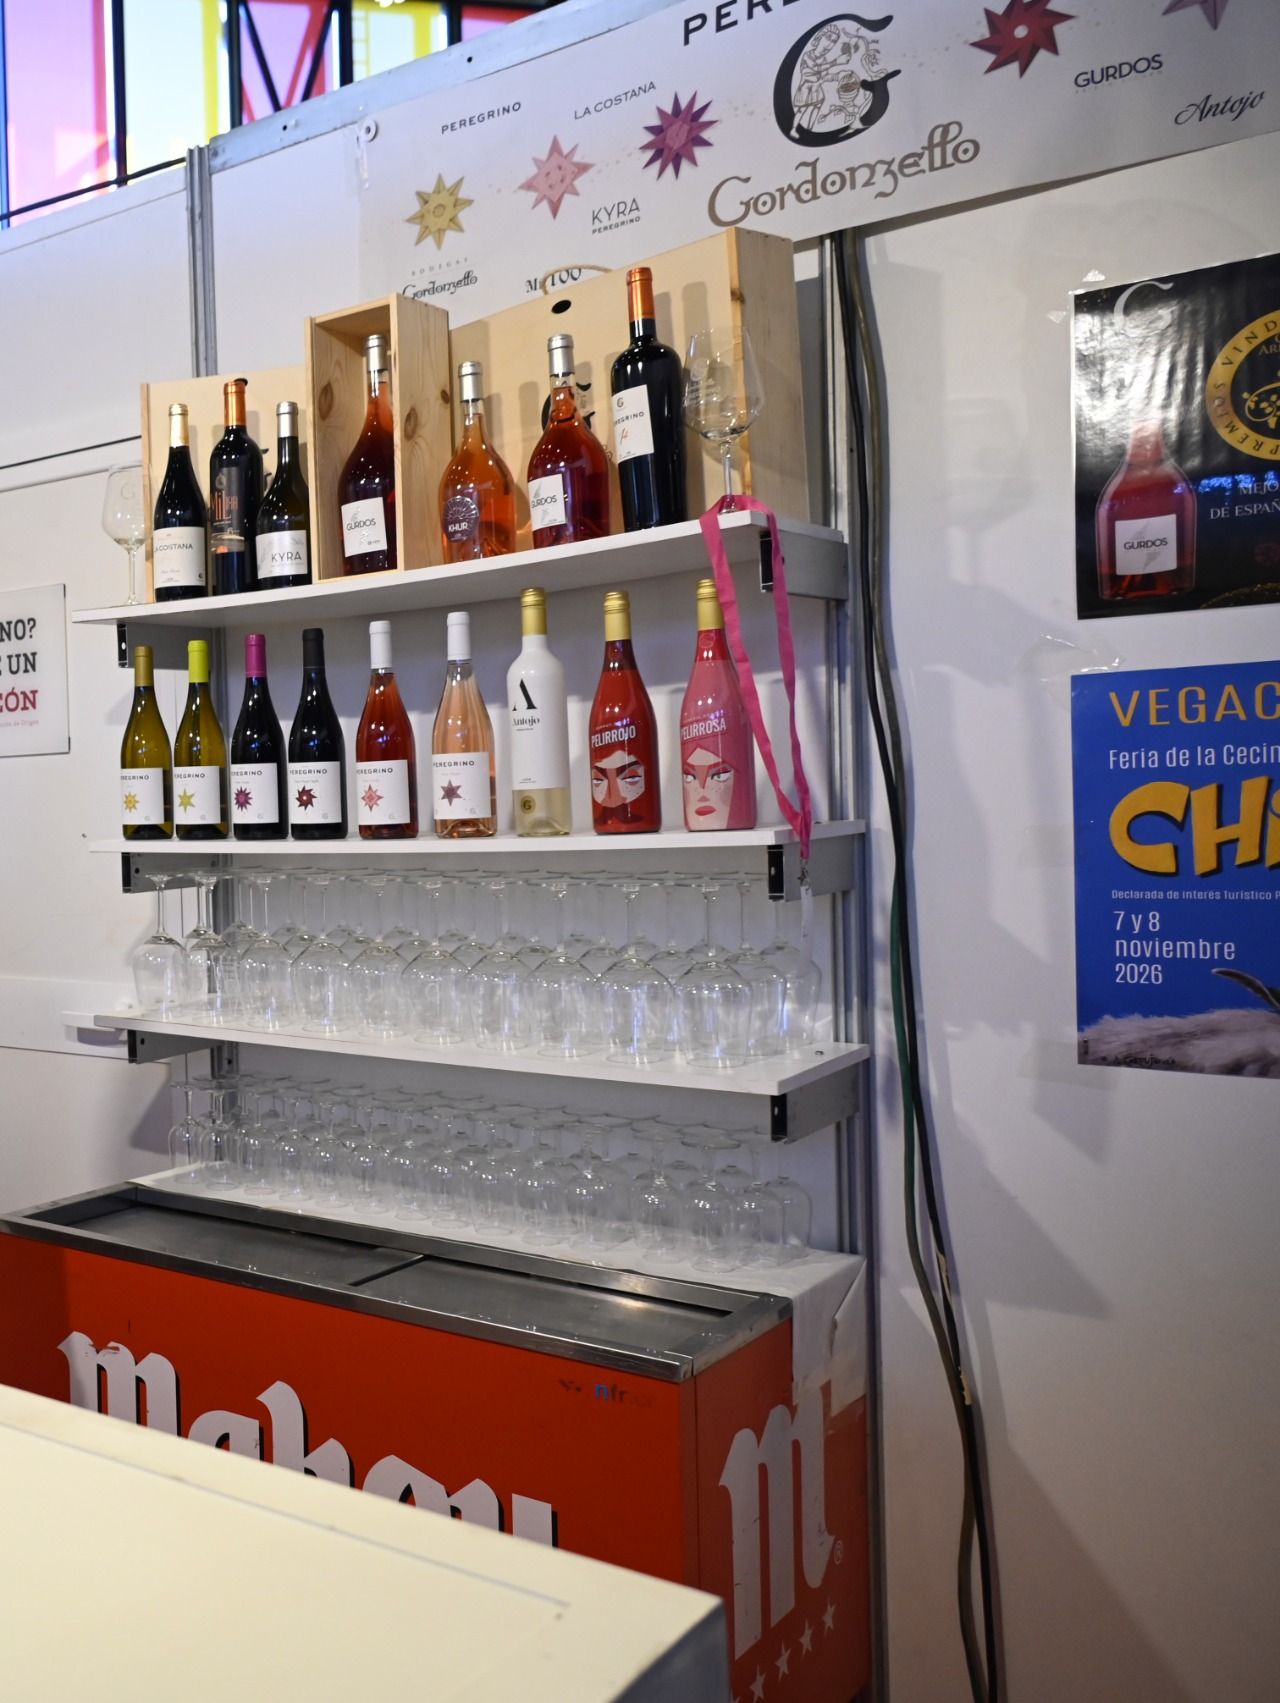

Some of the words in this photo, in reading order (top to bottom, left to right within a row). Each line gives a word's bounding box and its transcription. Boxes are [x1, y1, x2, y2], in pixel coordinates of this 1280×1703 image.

[683, 0, 801, 46] PER
[1074, 53, 1163, 88] GURDOS
[574, 105, 592, 120] LA
[594, 81, 657, 113] COSTANA
[1174, 91, 1265, 125] Antojo
[441, 102, 522, 135] PEREGRINO
[591, 198, 641, 226] KYRA
[592, 216, 641, 235] PEREGRINO
[346, 518, 377, 531] GURDOS
[1210, 507, 1230, 519] DE
[448, 522, 468, 532] KHUR
[1123, 537, 1168, 550] GURDOS
[271, 551, 302, 562] KYRA
[7, 652, 37, 675] UN
[1109, 681, 1280, 727] VEGAC
[591, 725, 636, 748] PELIRROJO
[683, 717, 727, 740] ELIRROSA
[1109, 748, 1159, 770] Feria
[1166, 747, 1189, 768] de
[1197, 746, 1216, 766] la
[1111, 889, 1164, 899] Declarada
[1166, 890, 1179, 899] de
[1182, 889, 1221, 900] interés
[1113, 911, 1125, 931] 7
[1131, 913, 1142, 934] y
[1148, 911, 1160, 931] 8
[1115, 938, 1236, 960] noviembre
[1115, 963, 1163, 985] 2026
